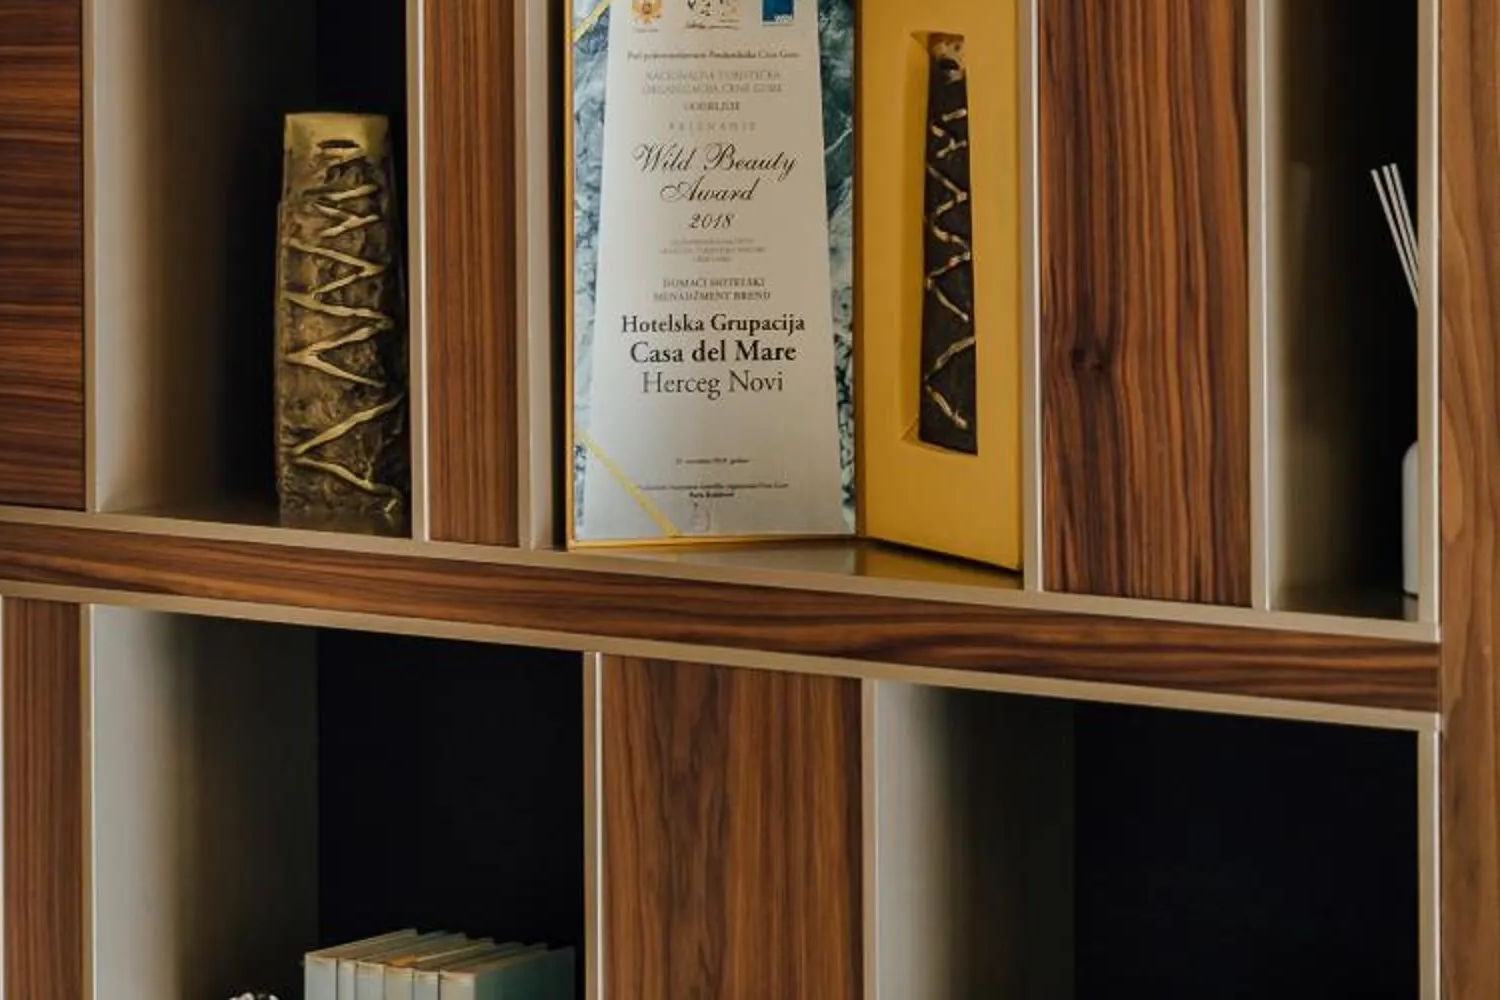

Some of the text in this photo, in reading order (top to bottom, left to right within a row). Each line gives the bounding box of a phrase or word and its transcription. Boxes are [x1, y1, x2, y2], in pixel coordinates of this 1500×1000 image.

[632, 142, 798, 181] Wild Beauty
[660, 174, 761, 202] Award
[690, 212, 735, 229] 2018
[621, 313, 805, 336] Hotelska Grupacija
[630, 339, 797, 363] Casa del Mare
[642, 369, 783, 401] Herceg Novi
